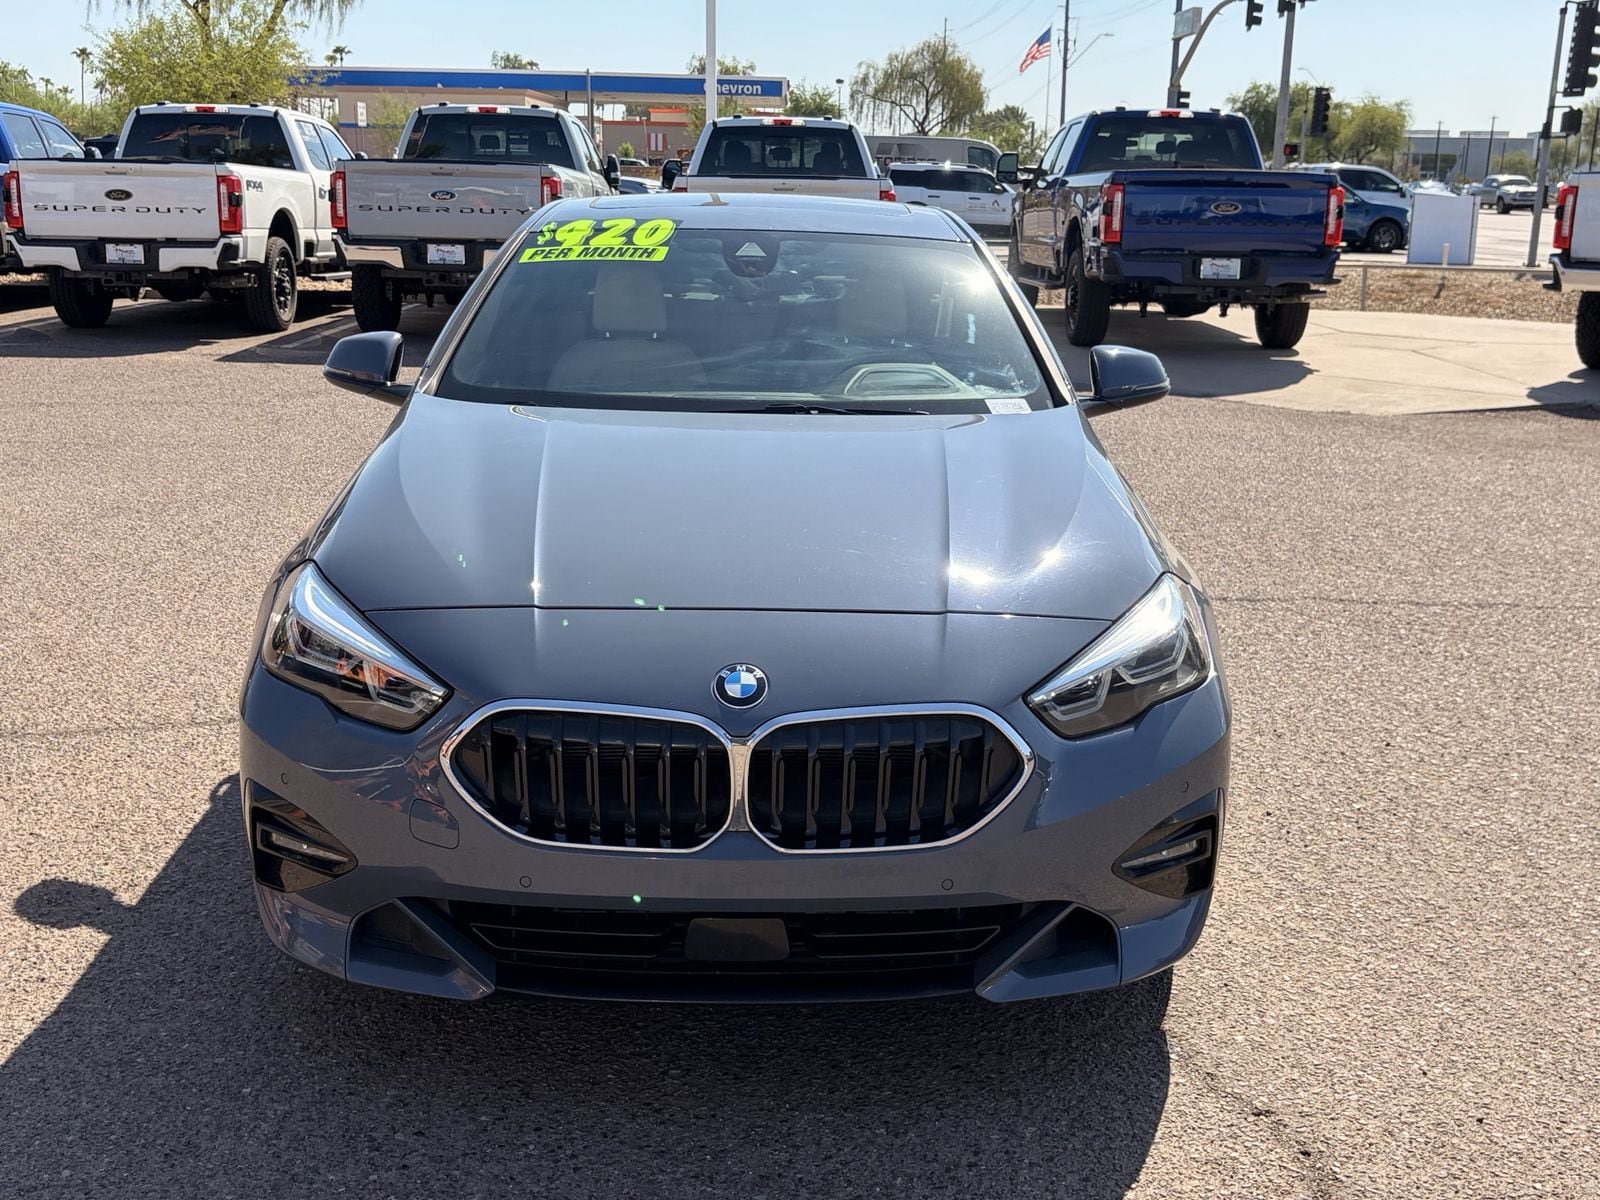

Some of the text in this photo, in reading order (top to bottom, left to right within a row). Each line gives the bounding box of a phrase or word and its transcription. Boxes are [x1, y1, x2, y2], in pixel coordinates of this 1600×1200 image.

[33, 203, 207, 215] SUPER DUTY
[358, 204, 530, 216] SUPER DUTY
[536, 218, 676, 246] $420
[527, 246, 657, 261] PER MONTH
[720, 664, 764, 679] BMW
